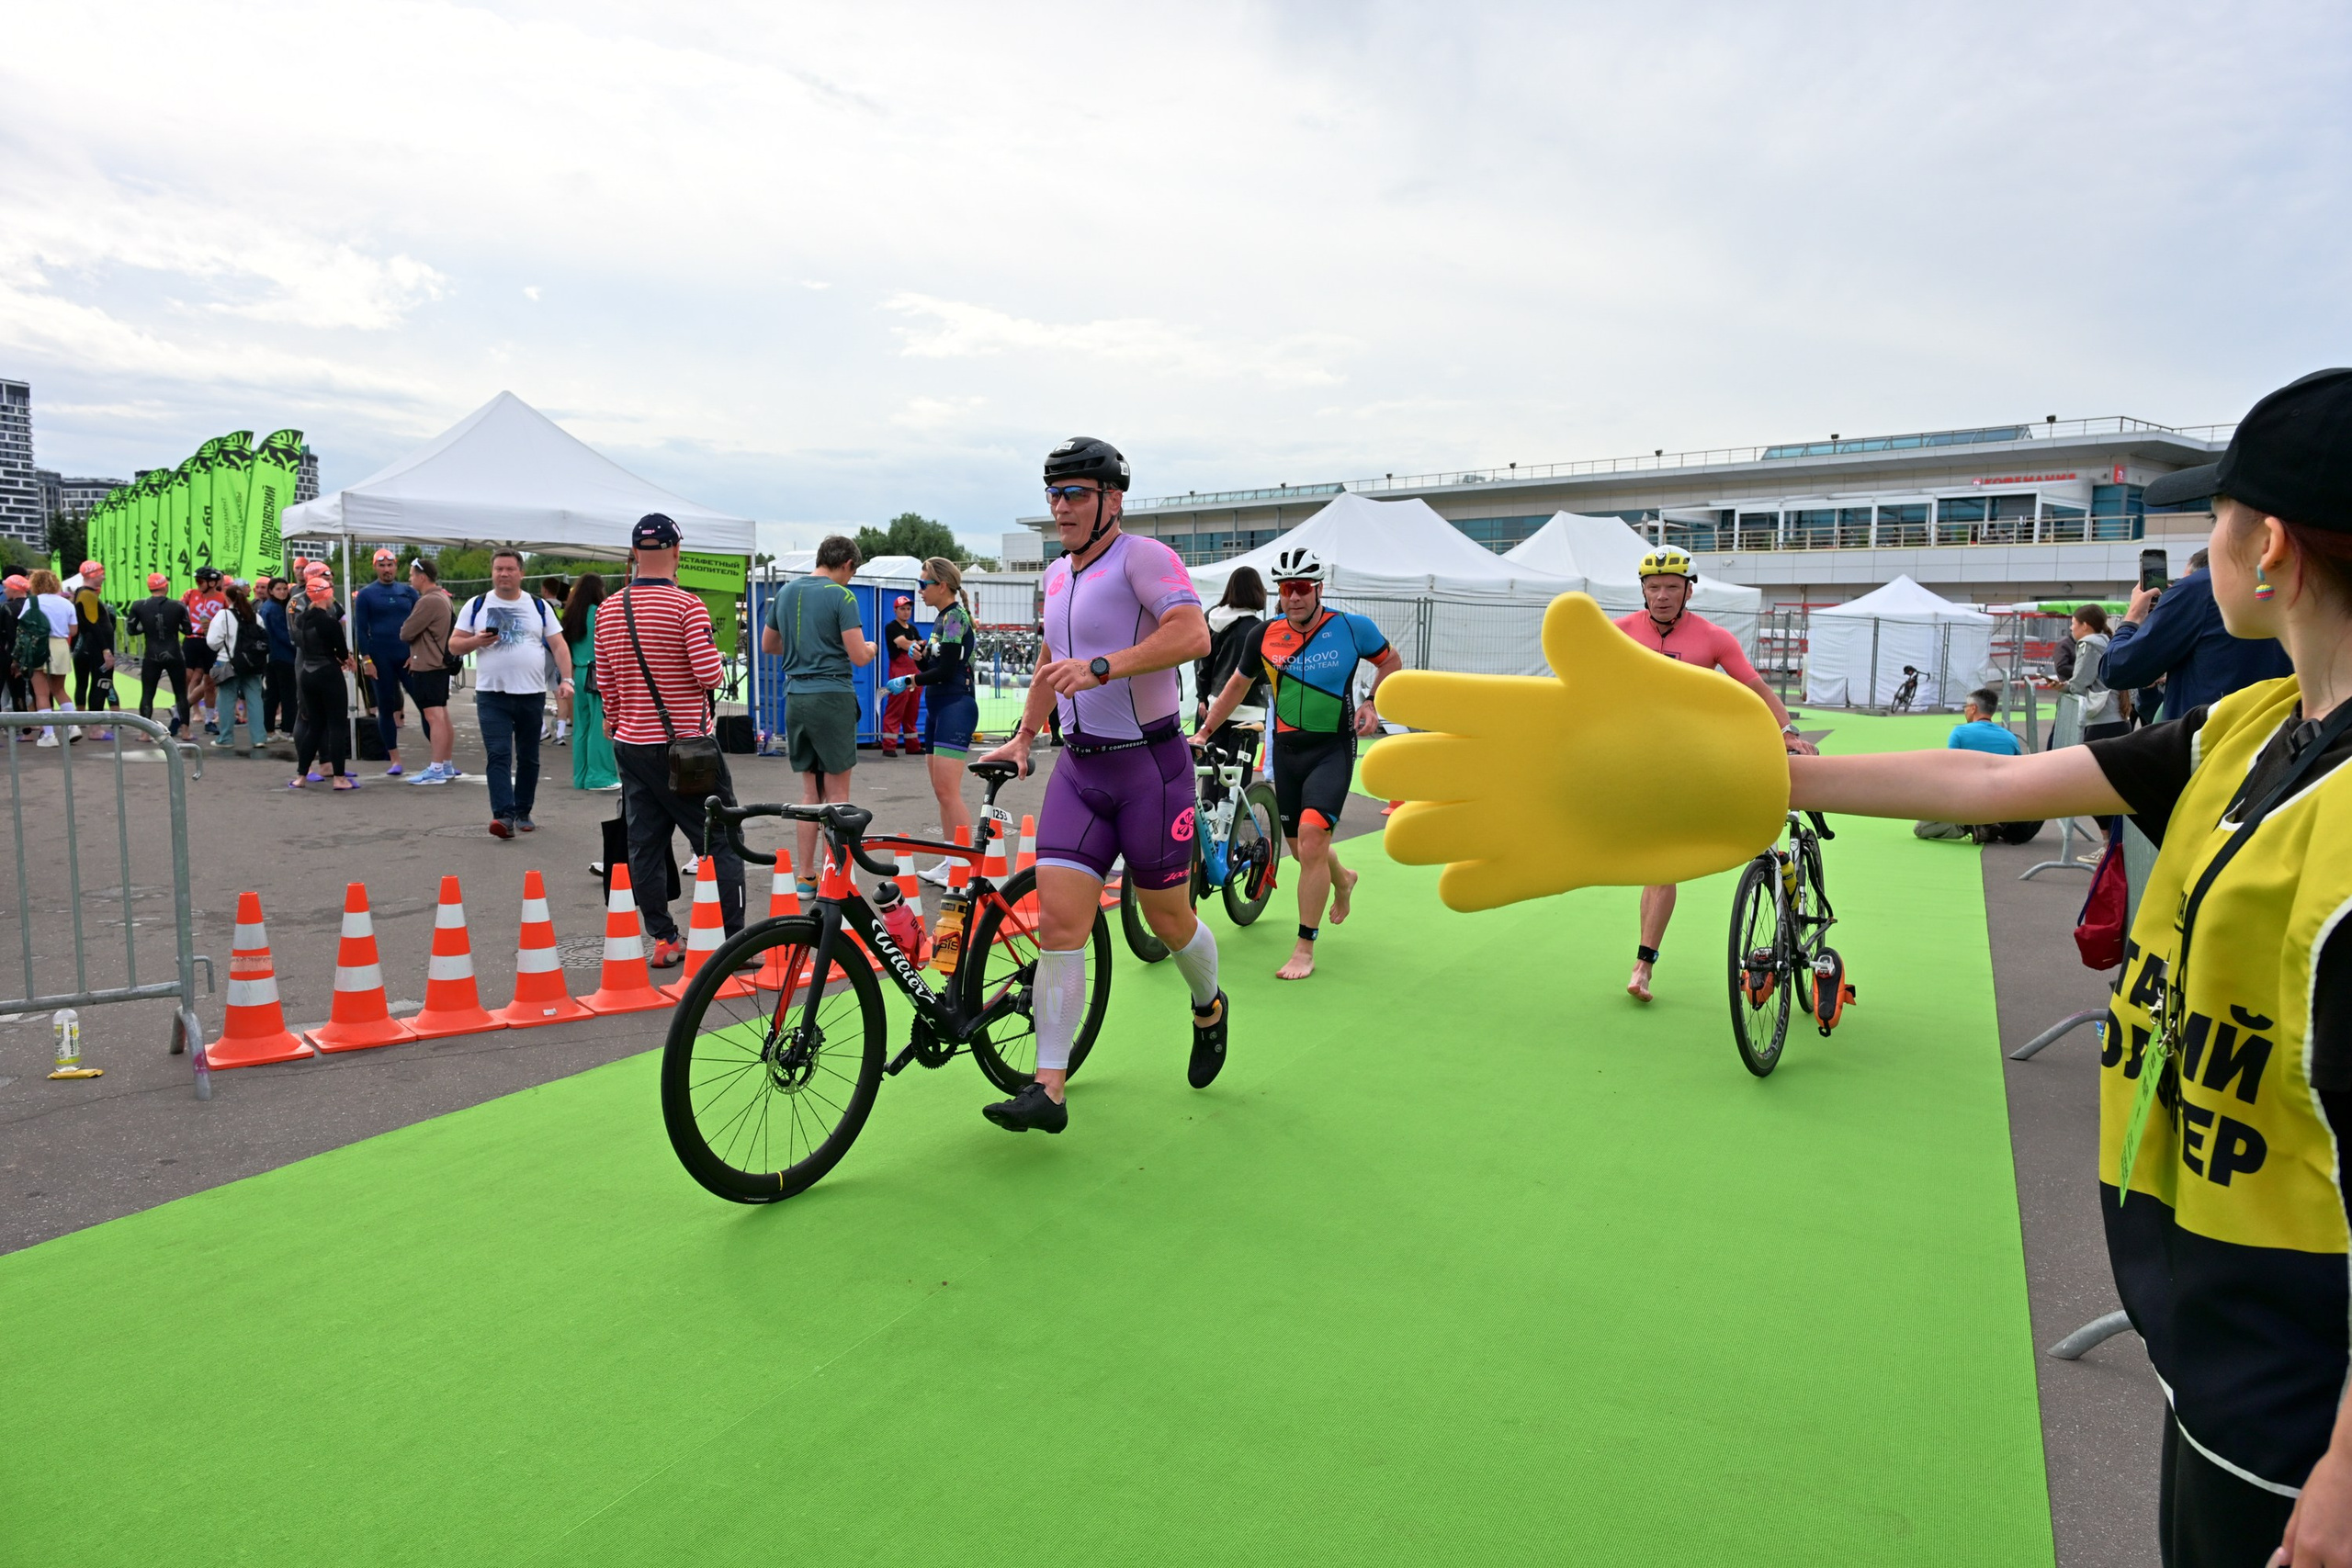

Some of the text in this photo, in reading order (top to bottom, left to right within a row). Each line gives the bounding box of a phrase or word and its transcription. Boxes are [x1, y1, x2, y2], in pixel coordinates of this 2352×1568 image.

[221, 497, 231, 552] Департамент
[258, 484, 276, 558] МОСКОВСКИЙ
[271, 526, 282, 561] СПОРТ
[678, 564, 740, 576] НАКОПИТЕЛЬ
[1272, 650, 1339, 665] SKOLKOVO
[1272, 660, 1340, 671] TRIATHLON TEAM
[992, 808, 1008, 821] 1253
[872, 919, 935, 1004] Wilier
